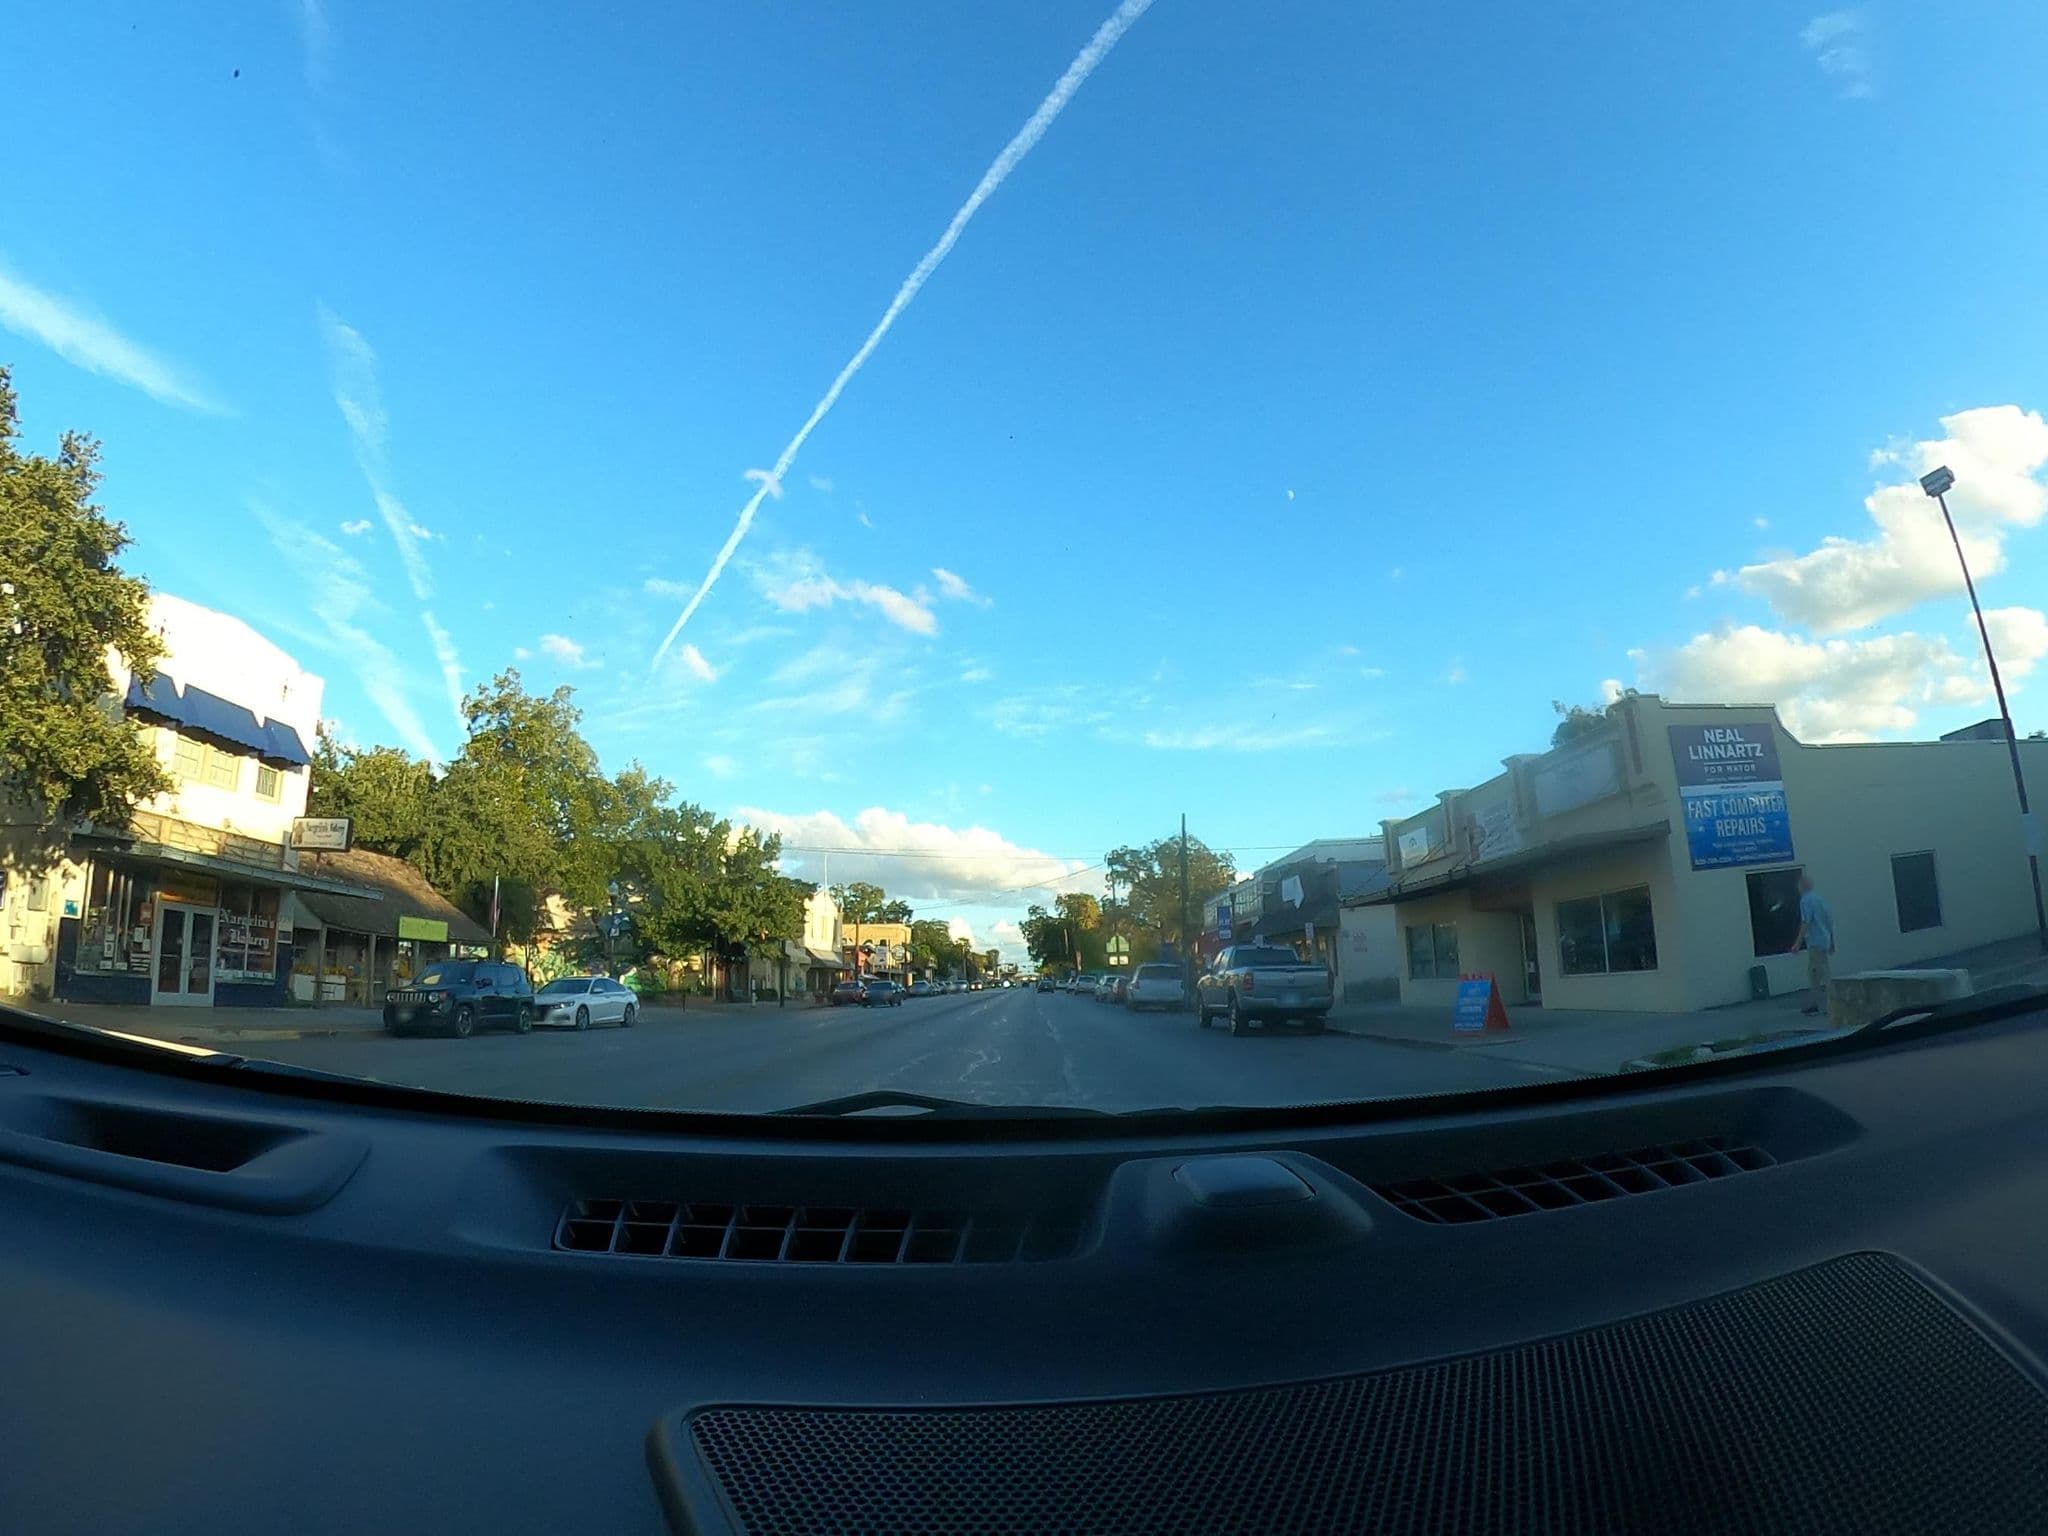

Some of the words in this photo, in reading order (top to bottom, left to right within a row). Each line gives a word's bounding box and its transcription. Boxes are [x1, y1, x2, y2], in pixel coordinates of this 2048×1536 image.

[1703, 728, 1744, 743] NEAL
[1688, 743, 1764, 760] LINNARTZ
[1704, 765, 1723, 774] FOR
[1726, 764, 1756, 773] MAYOR
[1687, 799, 1719, 819] FAST
[1721, 795, 1786, 817] COMPUTER
[1716, 816, 1767, 837] REPAIRS
